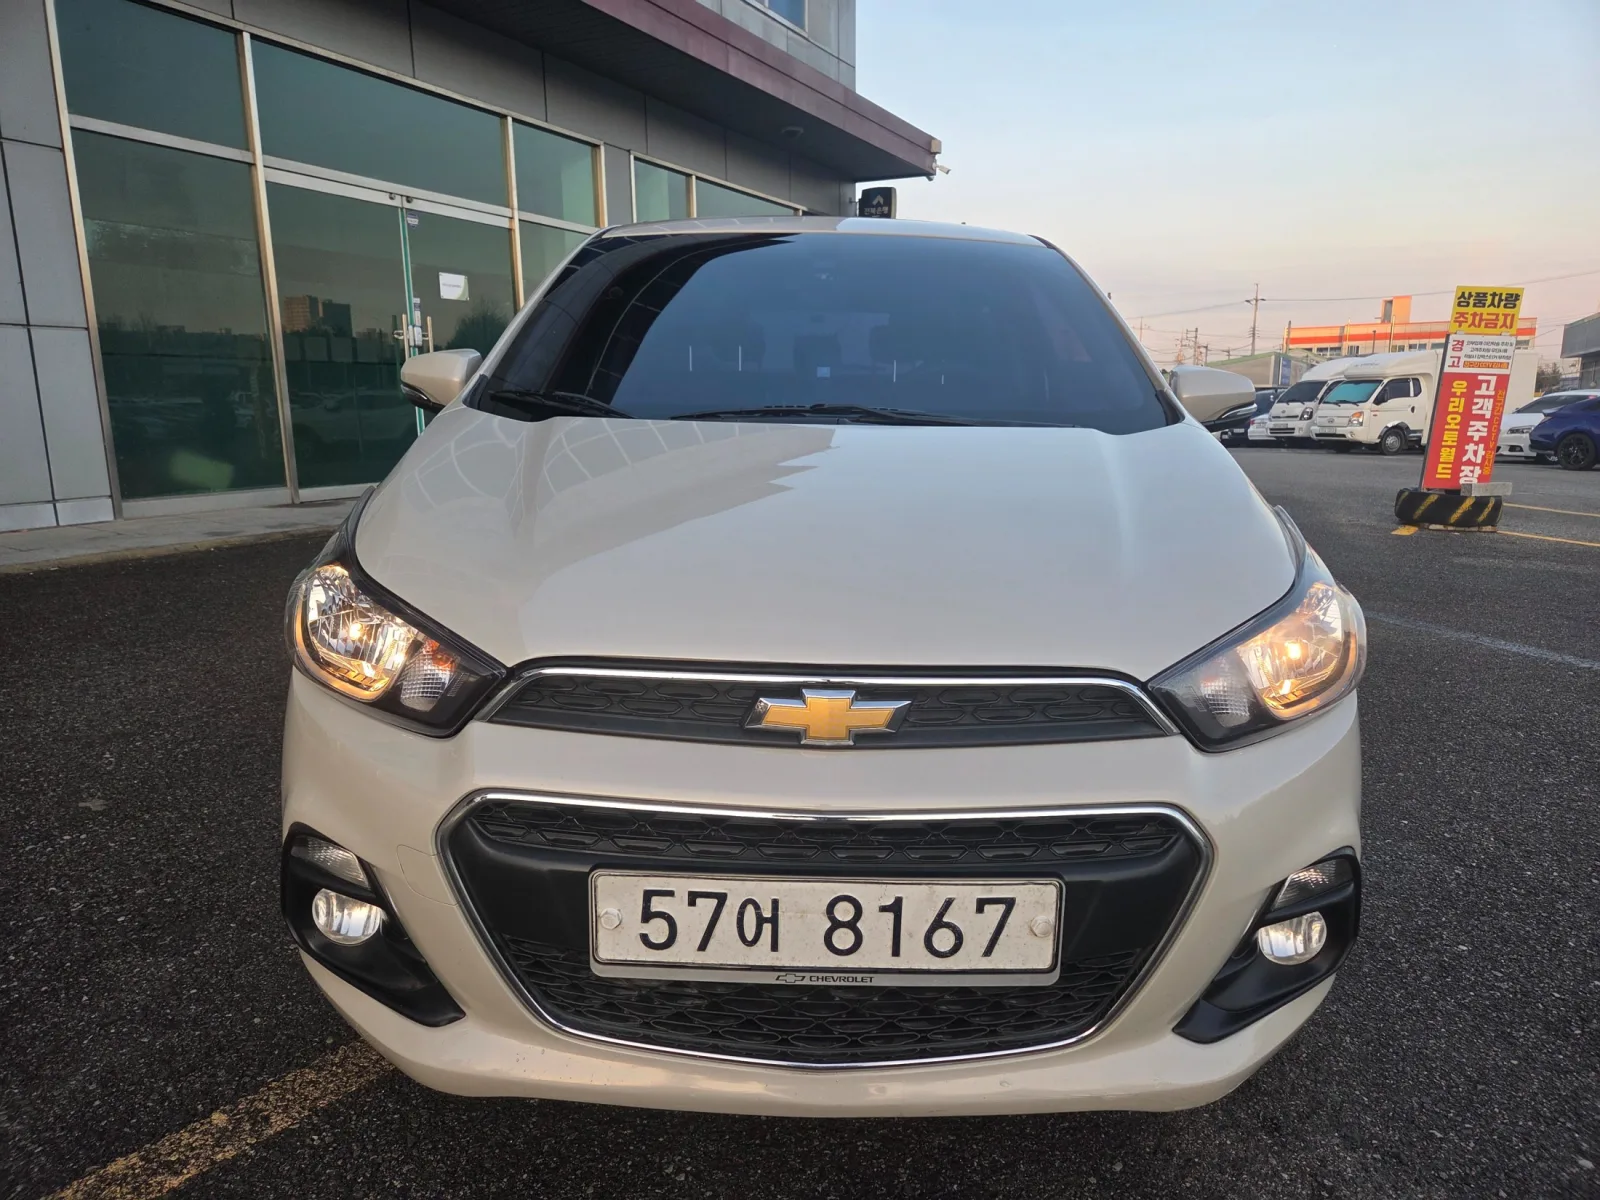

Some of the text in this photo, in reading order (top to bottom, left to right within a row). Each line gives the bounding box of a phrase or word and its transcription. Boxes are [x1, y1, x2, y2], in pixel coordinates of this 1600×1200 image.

[1456, 291, 1521, 309] 상품차량
[1453, 311, 1516, 329] 주차금지
[1448, 340, 1464, 368] 경고
[1459, 375, 1497, 484] 고객주차장
[639, 888, 1017, 958] 57어 8167
[809, 975, 875, 984] CHEVROLET
